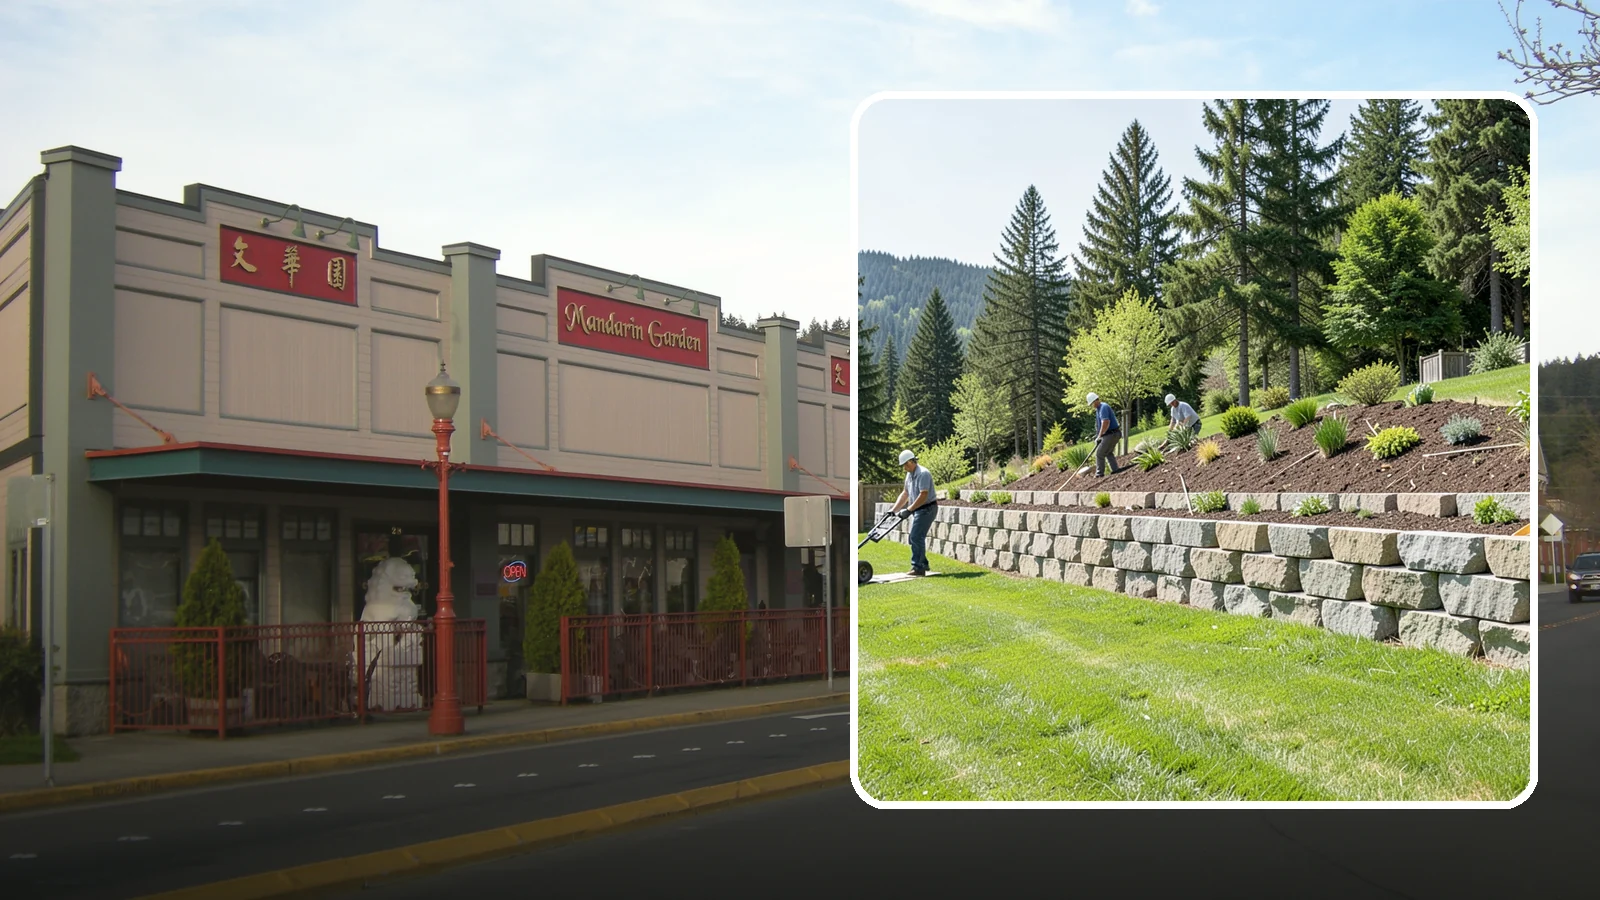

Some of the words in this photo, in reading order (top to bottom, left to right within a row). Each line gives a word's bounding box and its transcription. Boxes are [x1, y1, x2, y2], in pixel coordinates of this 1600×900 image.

[231, 236, 346, 291] 文華園
[565, 302, 643, 341] Mandarin
[648, 320, 701, 352] Garden
[503, 565, 526, 578] OPEN
